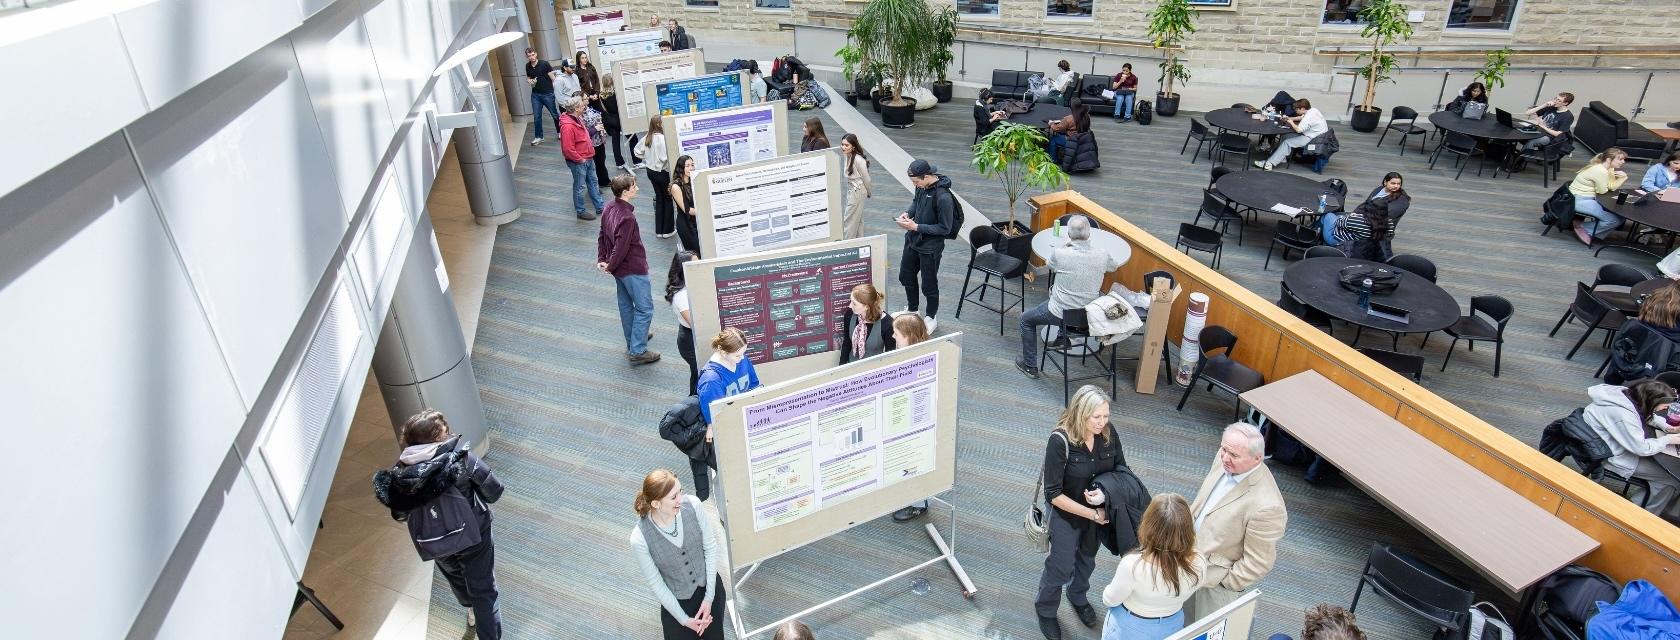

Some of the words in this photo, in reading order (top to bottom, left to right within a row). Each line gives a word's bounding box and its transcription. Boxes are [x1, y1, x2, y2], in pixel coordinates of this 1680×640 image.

[749, 407, 765, 415] From
[864, 369, 897, 382] Evolutionary
[898, 358, 934, 372] Psychologists
[788, 402, 807, 411] Shape
[818, 391, 842, 402] Negative
[868, 379, 884, 387] About
[899, 370, 913, 378] Field
